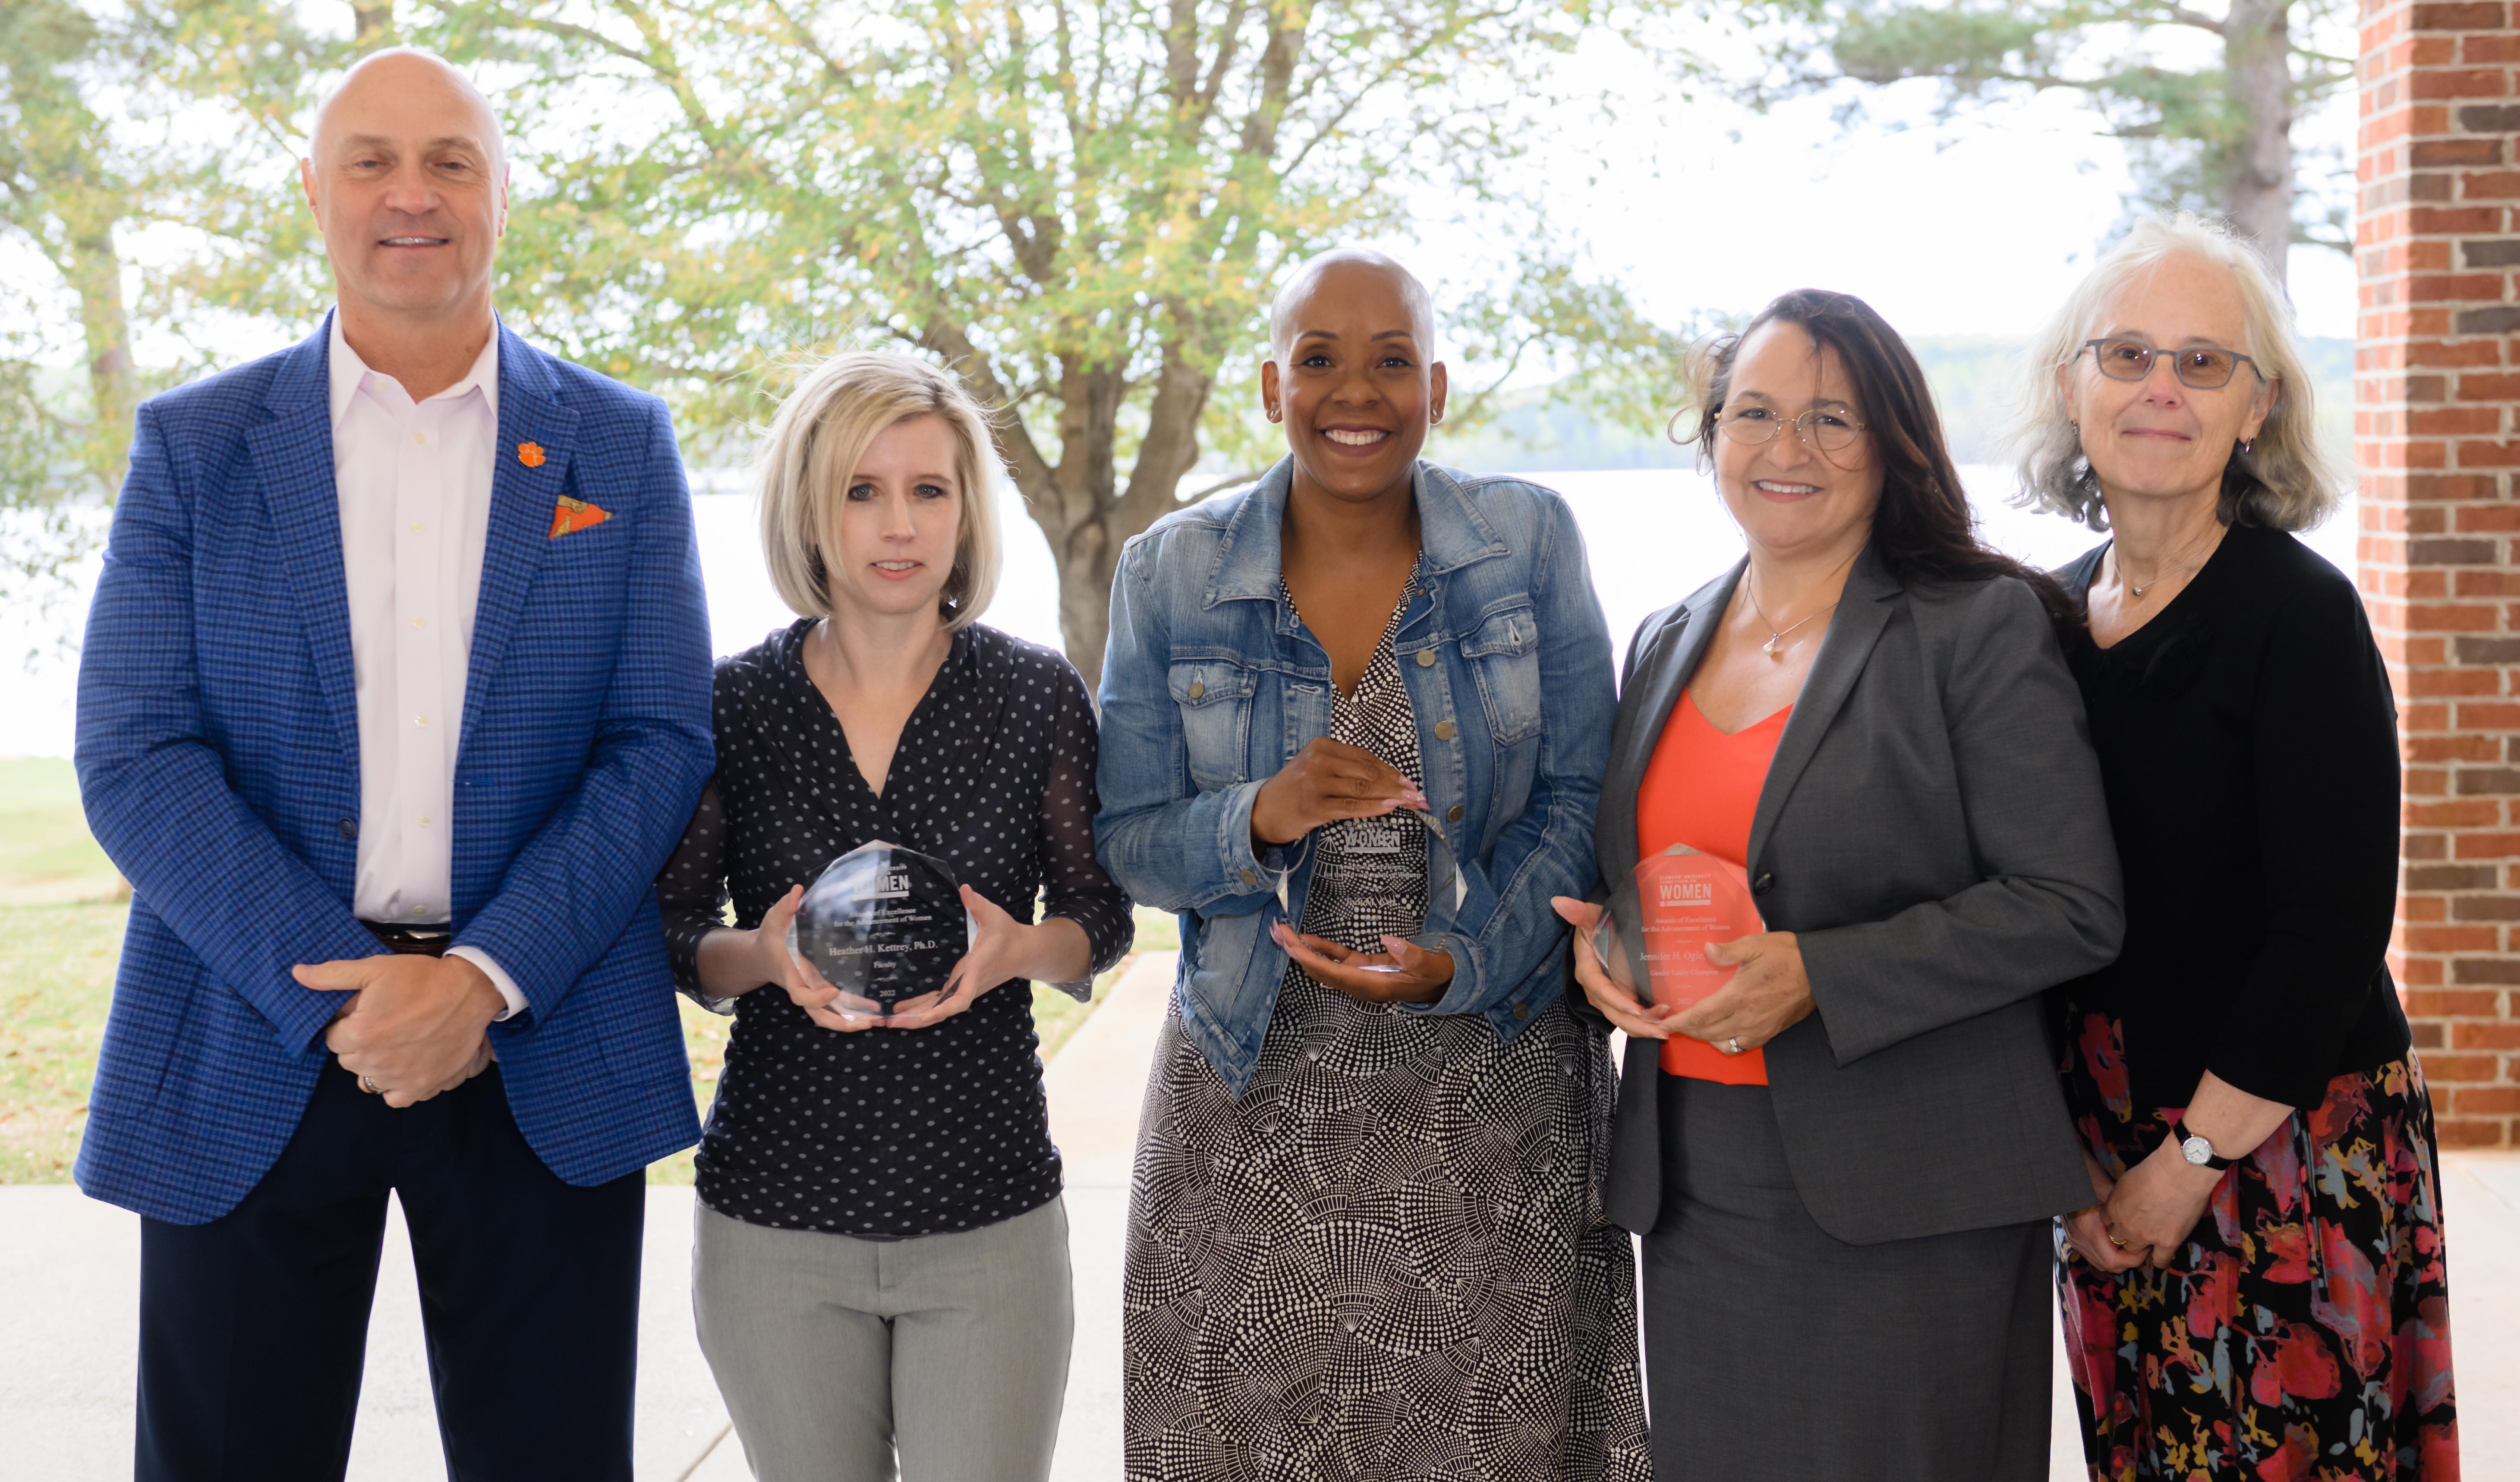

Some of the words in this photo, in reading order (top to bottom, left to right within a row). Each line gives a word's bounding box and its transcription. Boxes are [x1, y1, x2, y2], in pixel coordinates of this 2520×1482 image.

[1343, 831, 1400, 846] WOMEN
[1660, 883, 1711, 900] WOMEN
[829, 947, 863, 956] Heather
[865, 945, 876, 953] H.
[877, 944, 913, 952] Kettrey,
[914, 940, 939, 950] Ph.D.
[1640, 952, 1671, 961] Jennifer
[1673, 952, 1682, 960] H.
[1684, 951, 1706, 961] Ogle,
